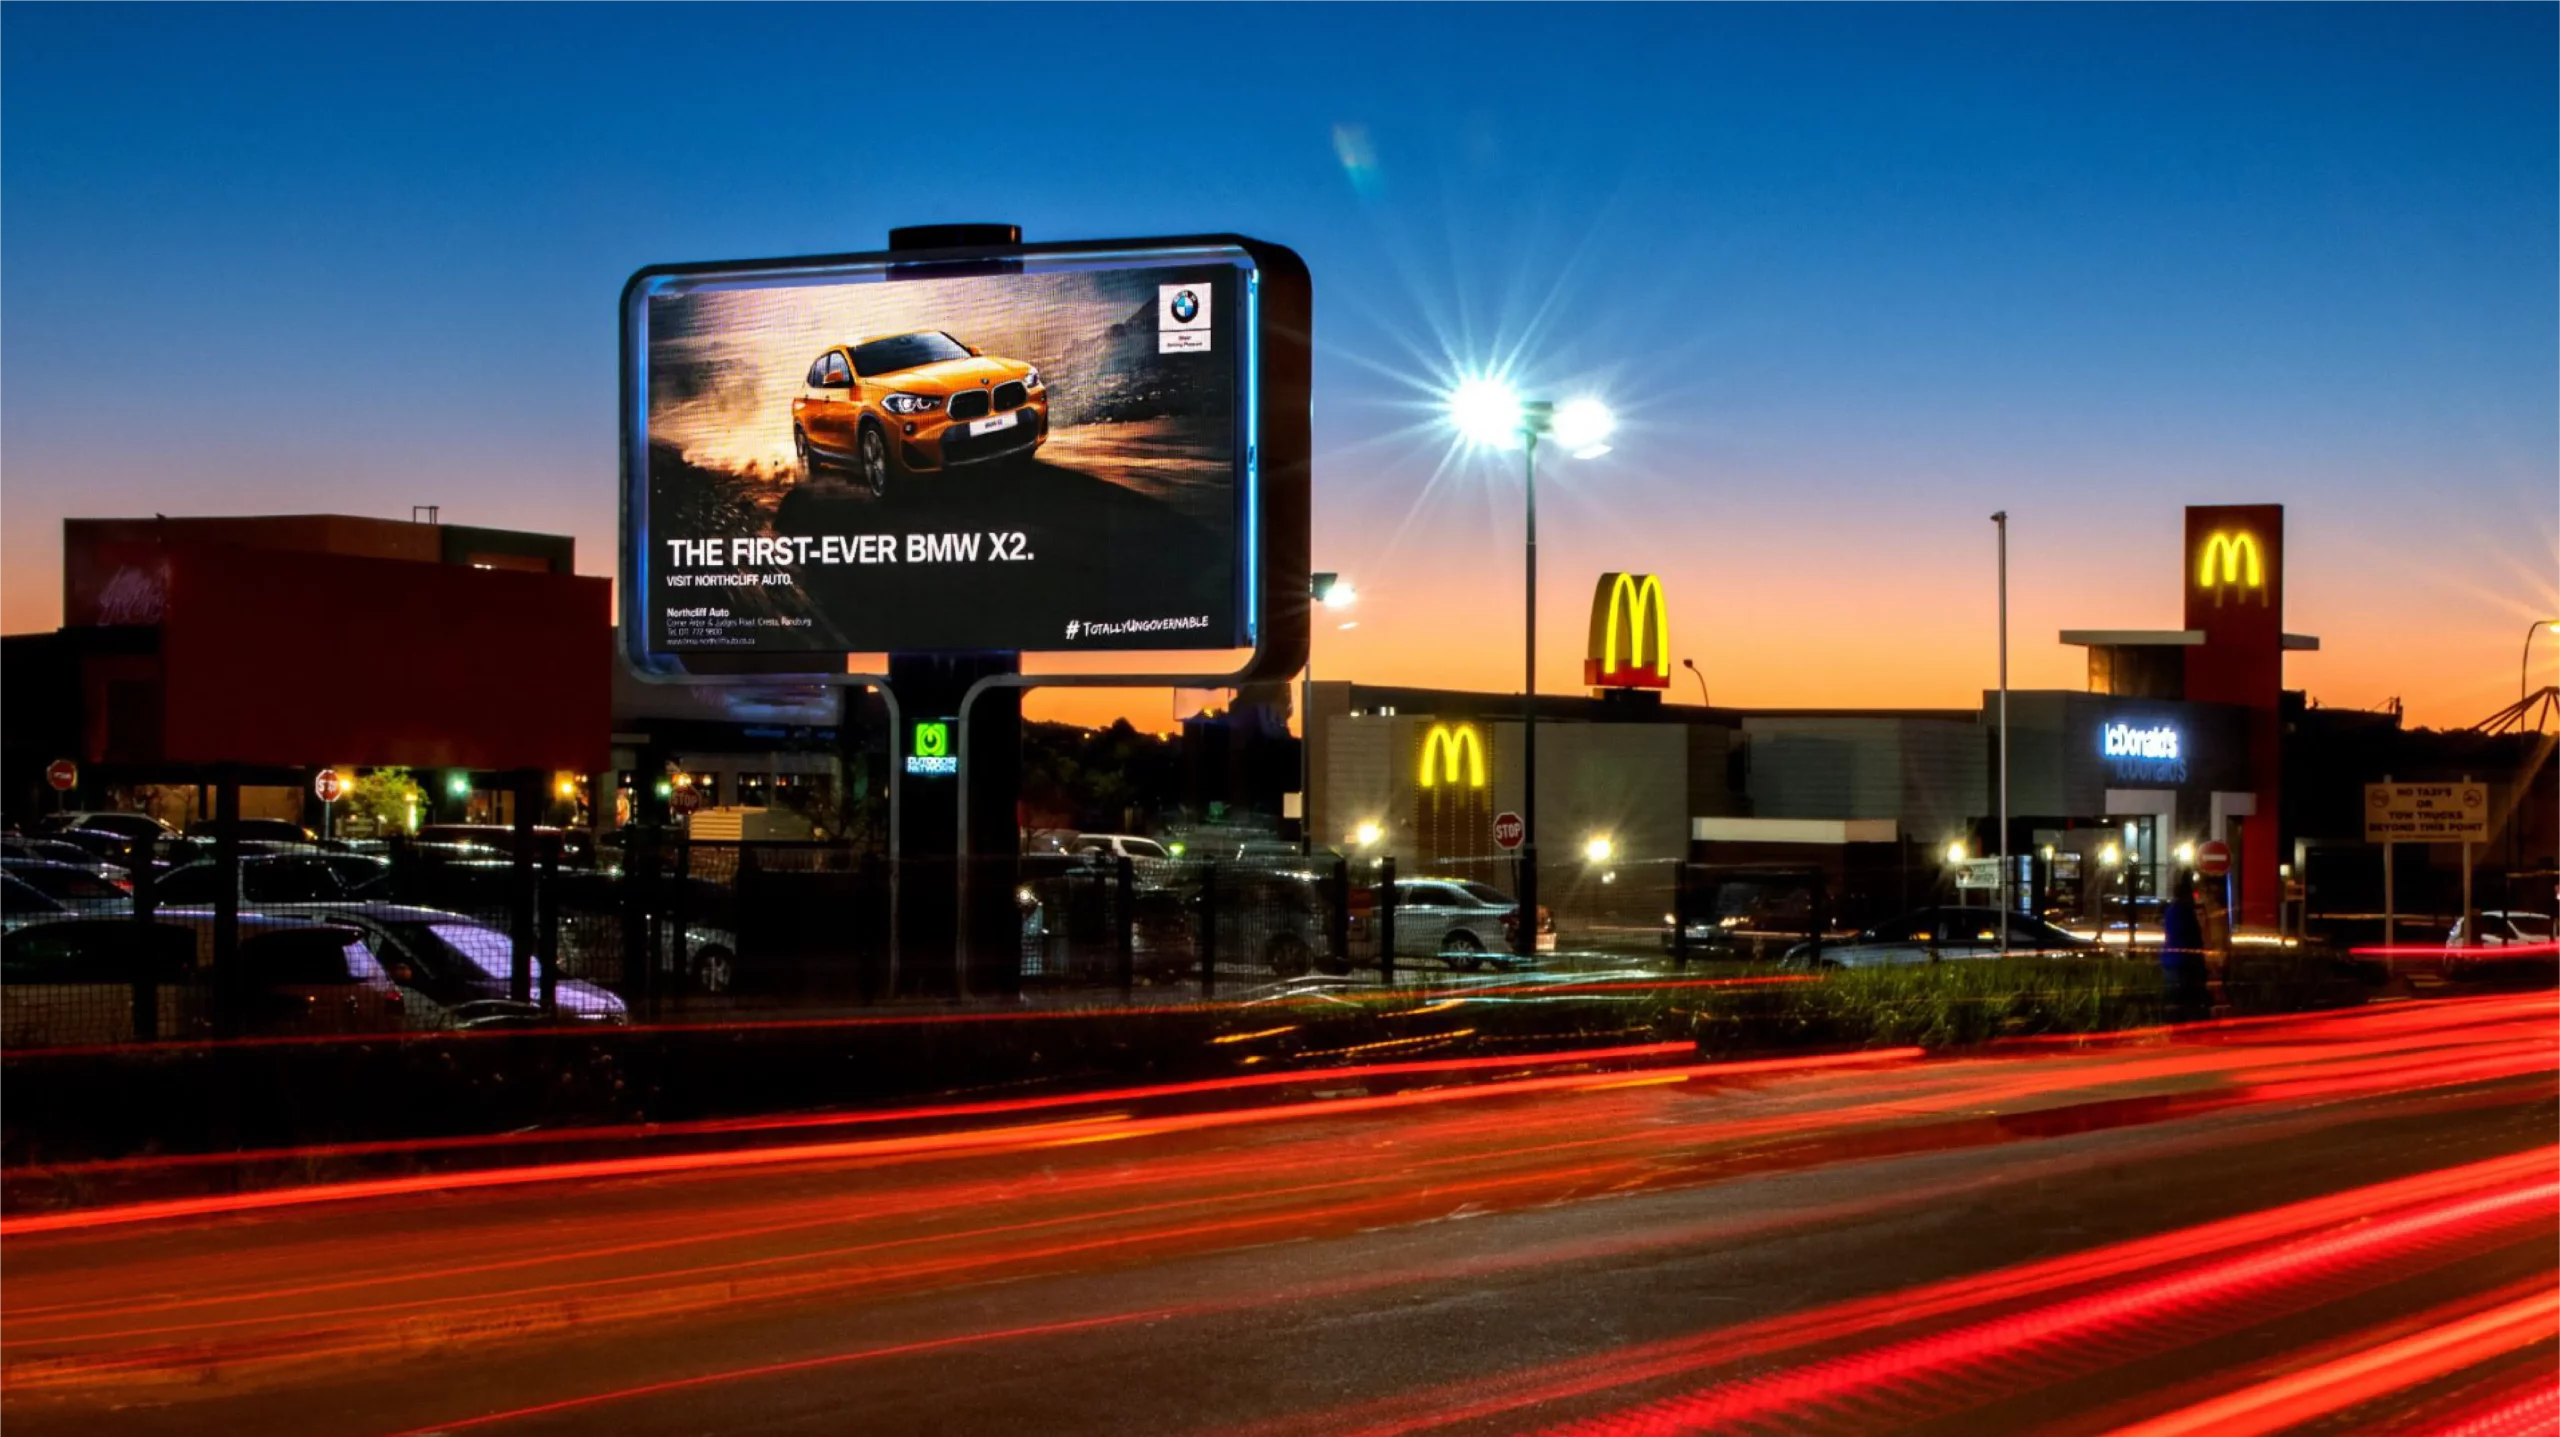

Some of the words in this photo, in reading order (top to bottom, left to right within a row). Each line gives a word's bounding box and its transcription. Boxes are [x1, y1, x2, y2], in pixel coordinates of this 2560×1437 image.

[667, 538, 724, 567] THE
[732, 534, 898, 566] FIRST-EVER
[906, 533, 981, 562] BMW
[988, 532, 1035, 561] X2.
[666, 575, 692, 587] VISIT
[694, 574, 759, 586] NORTHCLIFF
[761, 573, 794, 585] AUTO.
[666, 608, 706, 617] Northcliff
[709, 607, 730, 617] Auto
[2397, 787, 2413, 796] NO
[2388, 811, 2414, 820] TOW
[2417, 810, 2464, 820] TRUCKS
[1496, 822, 1521, 840] STOP
[2368, 823, 2416, 832] BEYOND
[2449, 823, 2483, 832] POINT
